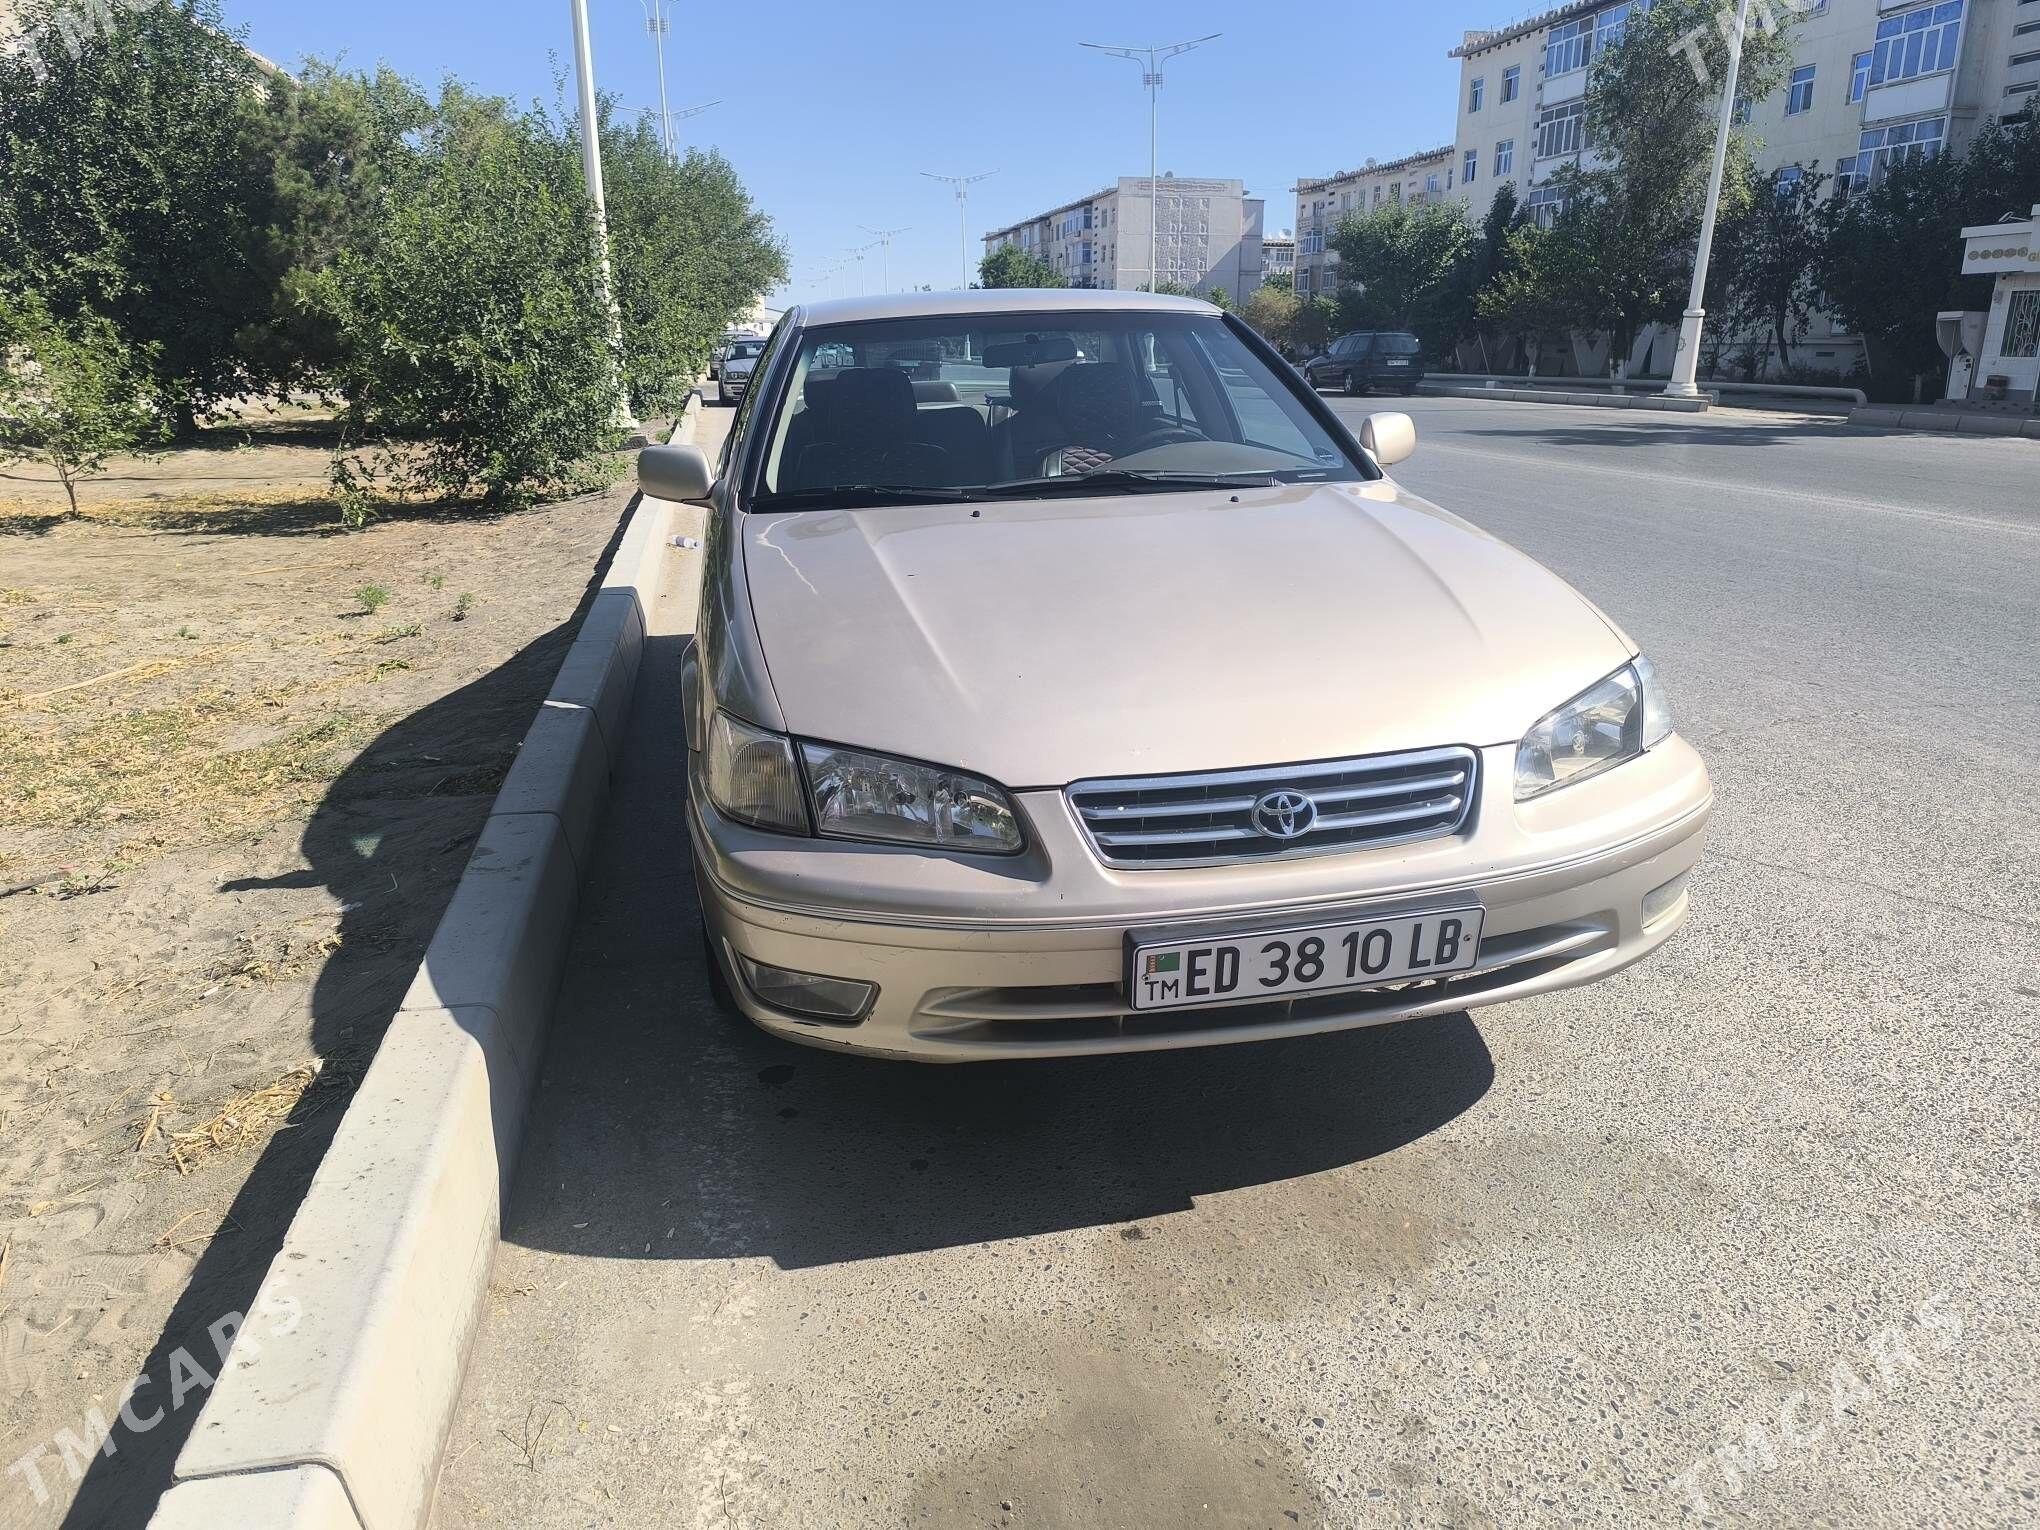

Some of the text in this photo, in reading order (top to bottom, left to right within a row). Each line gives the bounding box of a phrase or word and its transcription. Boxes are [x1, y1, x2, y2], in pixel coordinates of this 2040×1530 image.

[1186, 918, 1462, 997] ED 38 10 LB
[1144, 979, 1180, 1002] TM
